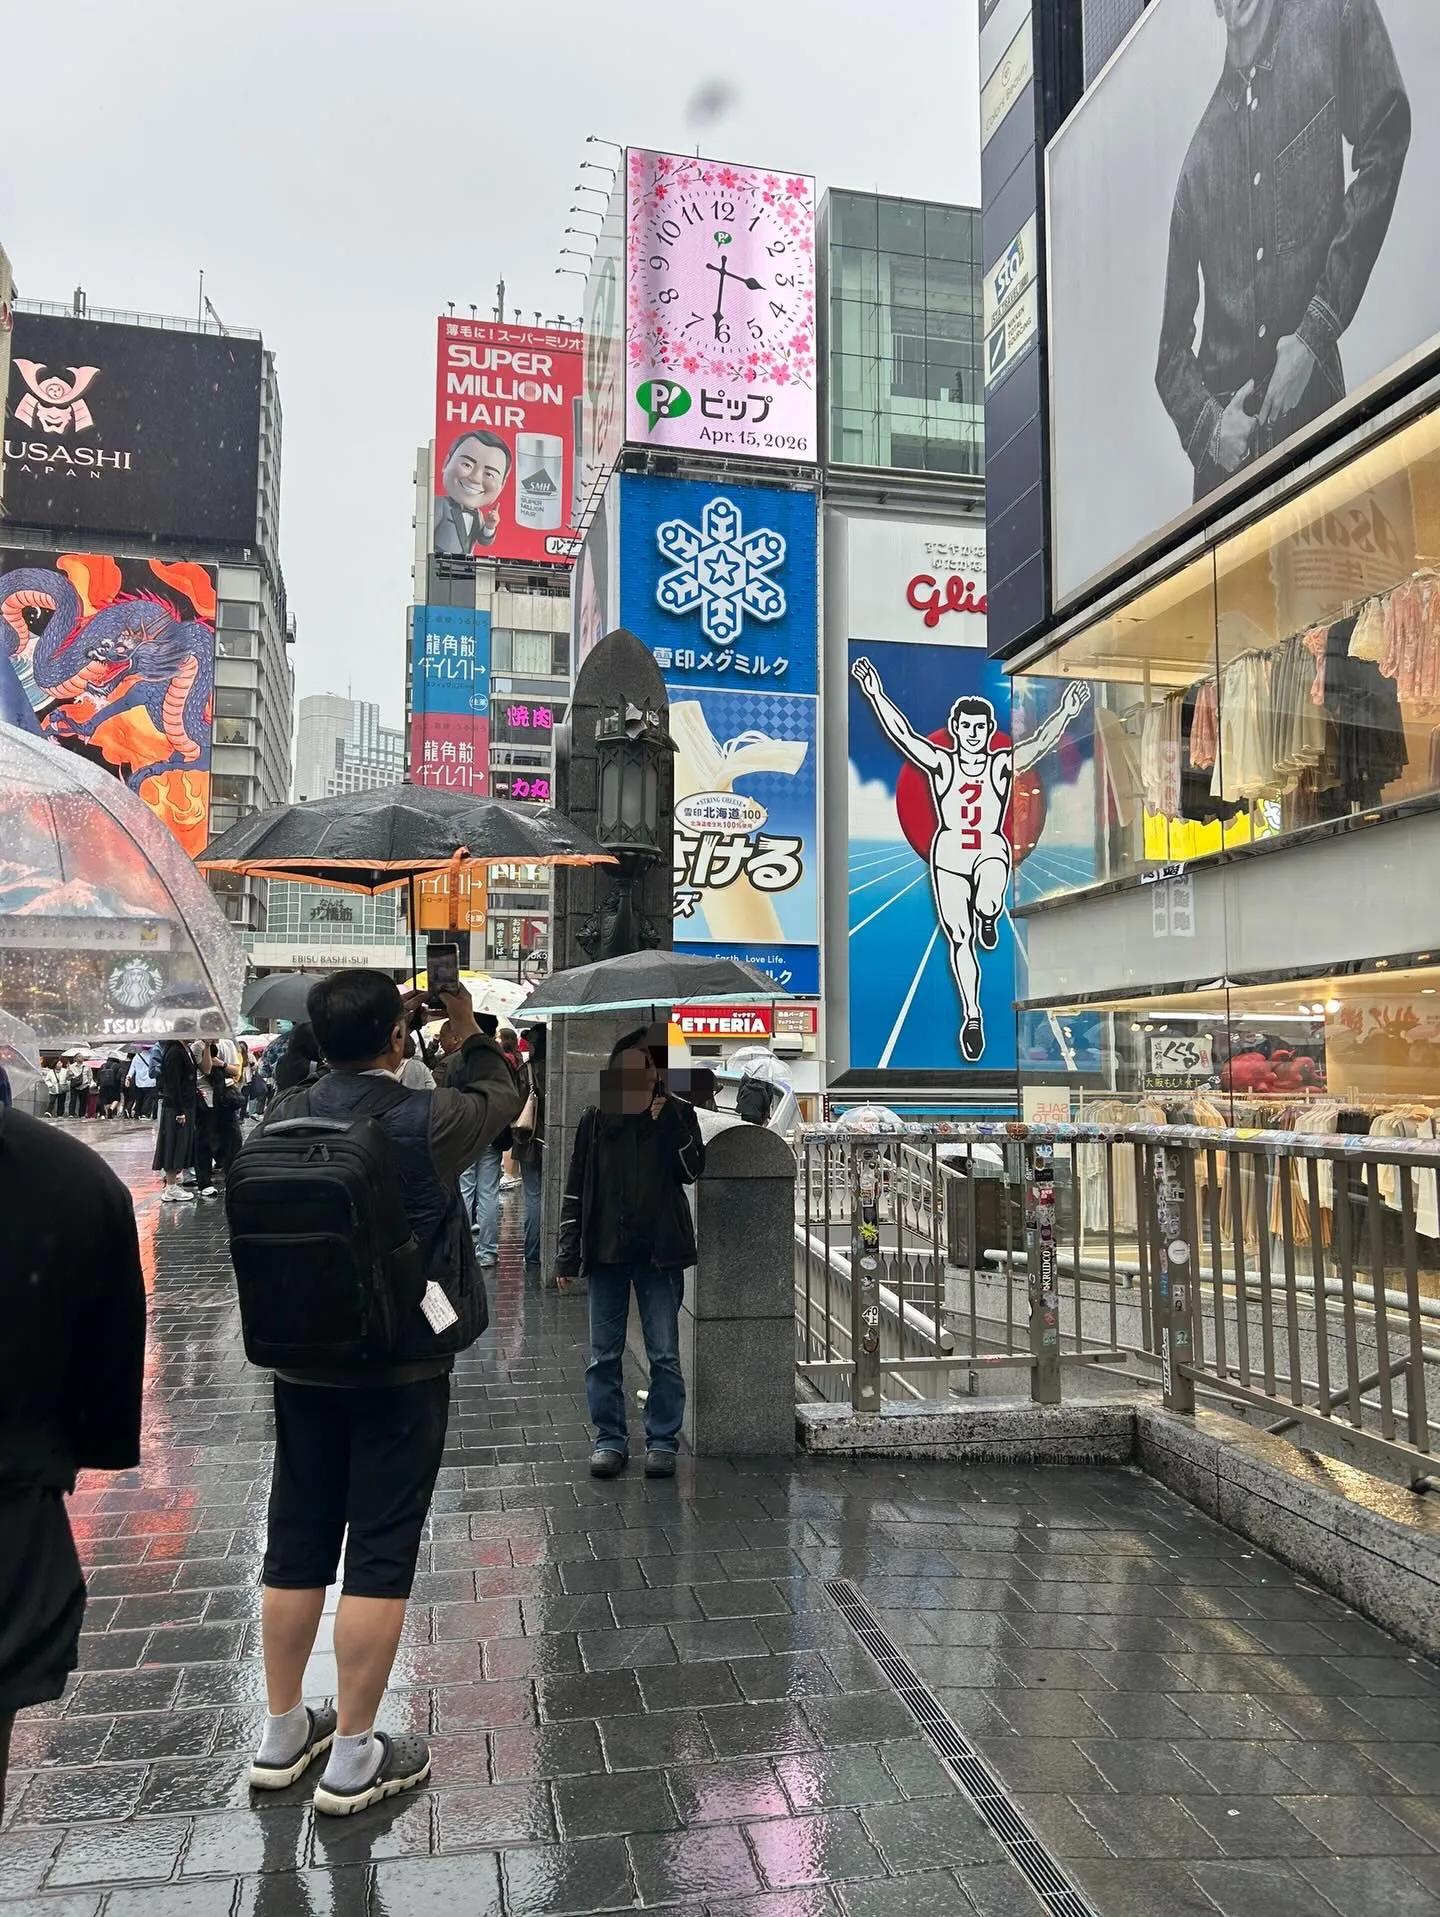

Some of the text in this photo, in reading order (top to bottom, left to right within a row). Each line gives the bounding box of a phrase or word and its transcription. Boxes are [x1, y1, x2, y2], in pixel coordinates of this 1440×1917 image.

[681, 202, 704, 225] 11
[711, 200, 735, 222] 12
[656, 220, 681, 247] 10
[748, 216, 761, 232] 1
[765, 240, 786, 258] 2
[649, 255, 670, 272] 9
[774, 273, 795, 288] 3
[658, 288, 679, 304] 8
[685, 311, 705, 329] 7
[768, 300, 787, 319] 4
[717, 323, 731, 344] 6
[746, 317, 763, 340] 5
[447, 344, 553, 377] SUPER
[447, 372, 563, 406] MILLION
[446, 400, 526, 429] HAIR
[701, 388, 774, 424] ピップ
[699, 426, 808, 451] Apr. 15, 2026
[530, 481, 551, 492] SMH
[426, 632, 477, 658] 龍角散
[653, 646, 789, 676] 雪印メグミルク
[507, 704, 554, 729] 焼肉
[424, 739, 476, 764] 龍角散
[511, 777, 550, 799] 力丸
[958, 780, 984, 850] グリコ
[292, 954, 319, 964] EBISU
[745, 954, 765, 964] Love
[767, 954, 786, 965] Life.
[1162, 1041, 1201, 1070] くくる
